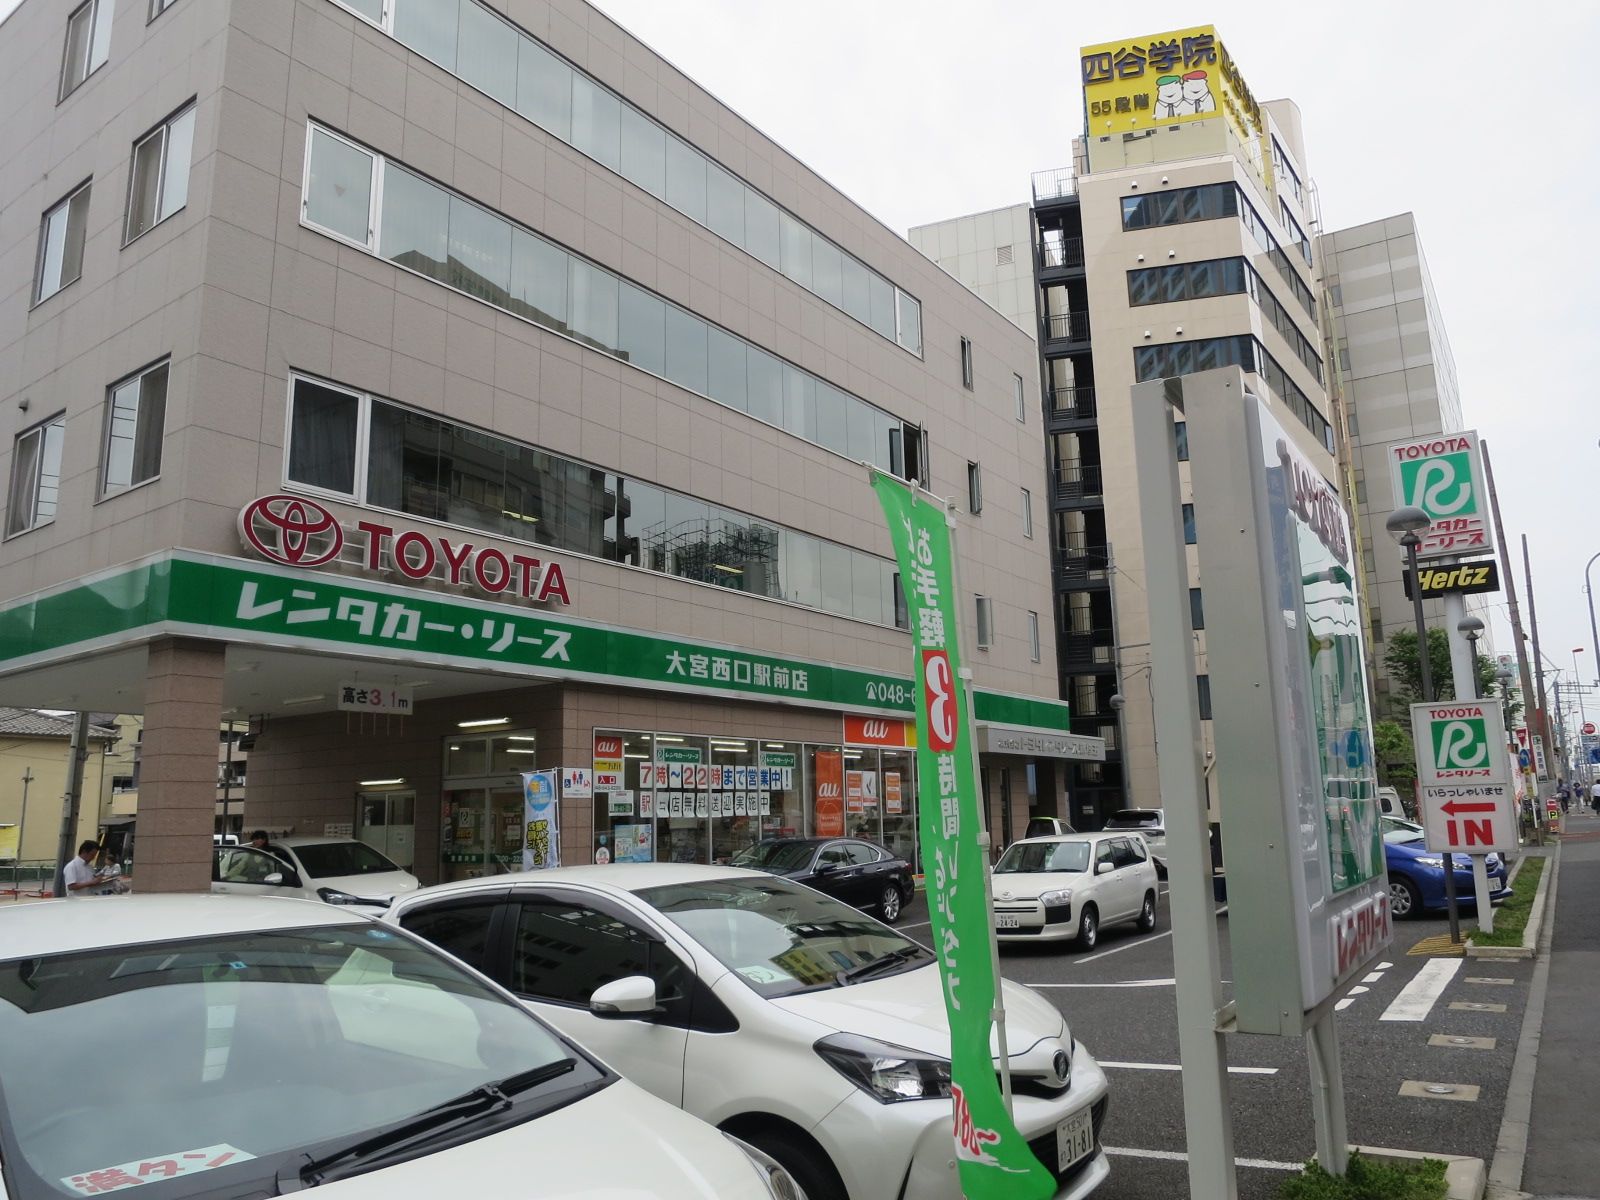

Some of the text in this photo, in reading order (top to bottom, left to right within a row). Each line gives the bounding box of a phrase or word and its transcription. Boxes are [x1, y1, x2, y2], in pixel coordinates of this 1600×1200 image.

[1081, 34, 1217, 86] 四谷学院
[1394, 437, 1472, 461] TOYOTA
[358, 521, 570, 605] TOYOTA
[1417, 566, 1490, 591] Hertz
[236, 582, 572, 662] レンタカー・リース
[666, 650, 808, 692] 大宮西口駅前店
[1430, 708, 1482, 719] TOYOTA
[863, 720, 889, 739] au
[597, 741, 618, 753] au
[600, 775, 616, 784] 入口
[1437, 769, 1490, 779] レンタリース
[819, 783, 840, 798] au
[1428, 786, 1504, 798] いらっしゃいませ
[1446, 819, 1494, 846] IN
[1066, 1125, 1091, 1163] 31-81
[71, 1152, 236, 1193] 満タン
